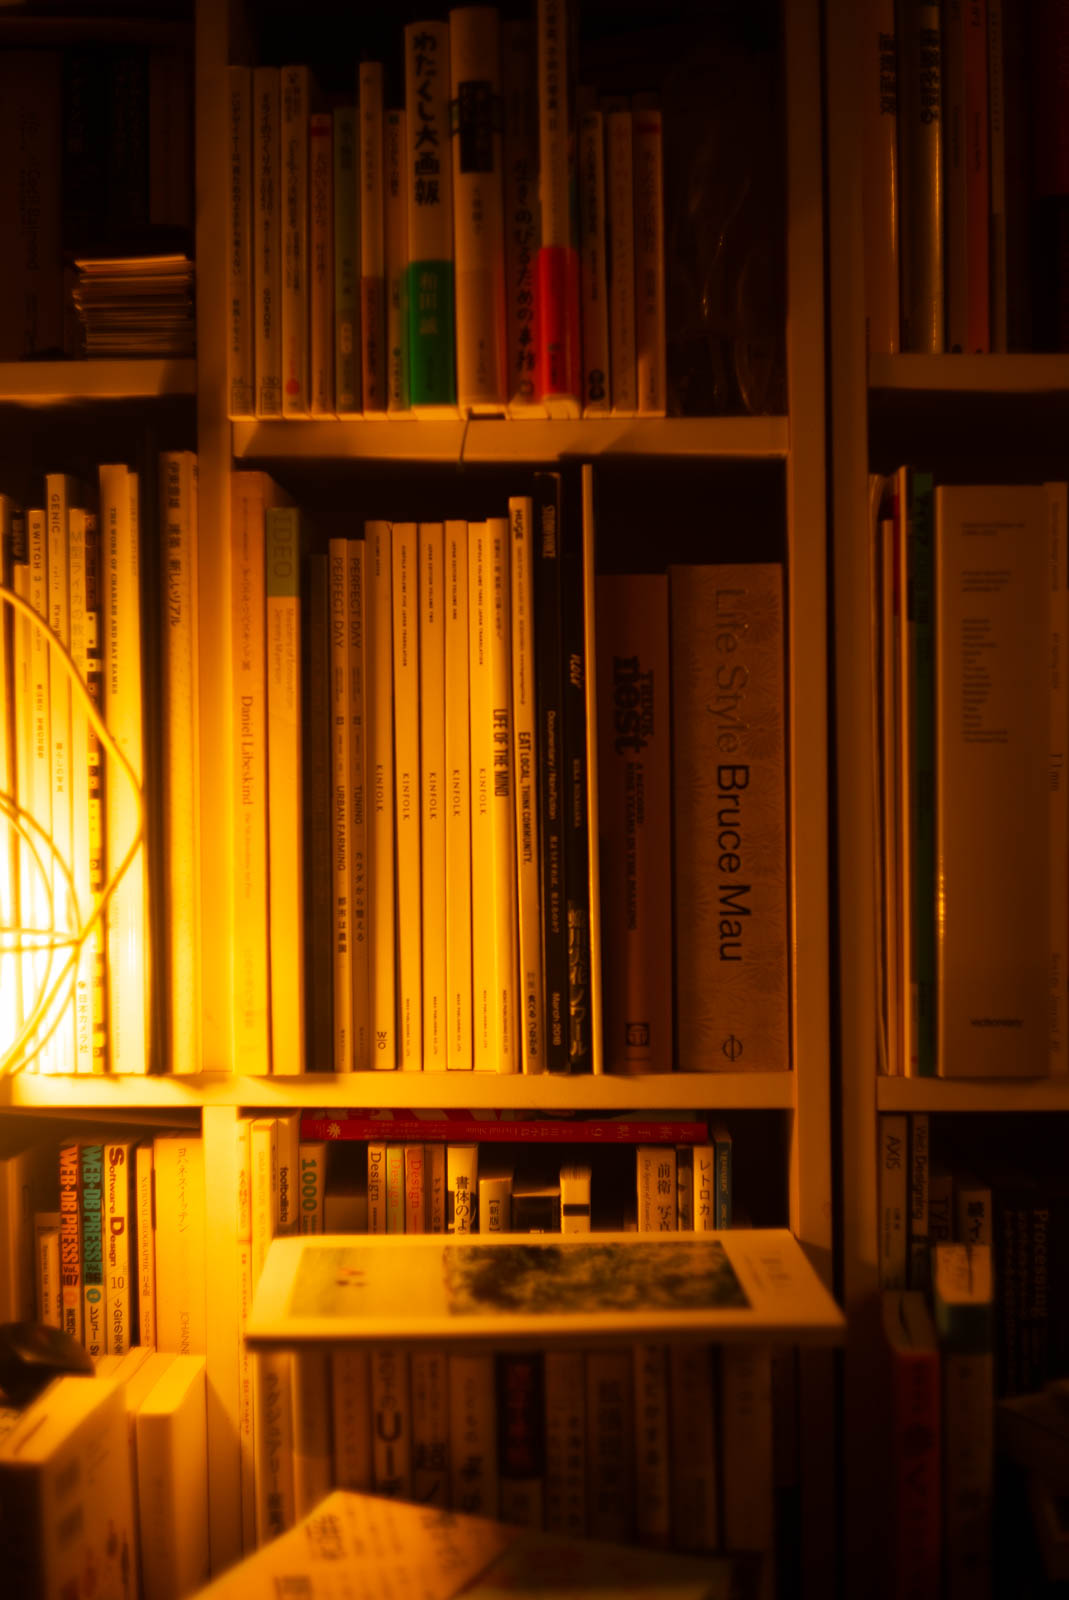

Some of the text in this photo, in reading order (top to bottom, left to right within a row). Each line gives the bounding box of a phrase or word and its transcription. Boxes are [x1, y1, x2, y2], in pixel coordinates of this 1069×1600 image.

[413, 31, 440, 206] わたくし大画報
[50, 494, 60, 534] GENIC
[514, 508, 524, 540] HUGE
[542, 504, 556, 533] STUDIO
[33, 523, 42, 569] SWITCH
[111, 558, 118, 570] OF
[273, 515, 293, 579] IDEO
[333, 556, 344, 616] PERFECT
[350, 557, 361, 617] PERFECT
[333, 620, 344, 648] DAY
[351, 620, 361, 649] DAY
[240, 695, 254, 739] Daniel
[613, 655, 649, 756] nest
[493, 709, 509, 797] LIFE OF THE MIND
[545, 710, 557, 766] Documentary
[240, 742, 254, 806] Libeskind
[376, 764, 384, 813] KINFOLK
[402, 772, 411, 821] KINFOLK
[428, 772, 437, 820] KINFOLK
[452, 769, 461, 818] KINFOLK
[478, 768, 487, 816] KINFOLK
[519, 731, 533, 865] EAT LOCAL, THINK COMMUNITY.
[707, 587, 751, 963] Life Style Bruce Mau
[336, 785, 346, 822] URBAN
[353, 785, 363, 825] TUNING
[337, 824, 346, 871] FARMING
[551, 992, 562, 1021] March
[369, 1151, 382, 1202] Design
[886, 1135, 901, 1170] AXIS
[177, 1147, 191, 1233] ヨハネス・イッテン
[280, 1167, 289, 1222] footballista
[302, 1159, 318, 1211] 1000
[389, 1159, 401, 1207] Design
[408, 1160, 421, 1208] Design
[657, 1163, 672, 1195] 前衛
[699, 1159, 711, 1231] レトロカー
[109, 1147, 125, 1289] Software Design 10
[142, 1176, 151, 1273] NATIONAL GEOGRAPHIC
[455, 1175, 471, 1233] 書体のよ
[61, 1213, 80, 1265] PRESS
[84, 1213, 103, 1264] PRESS
